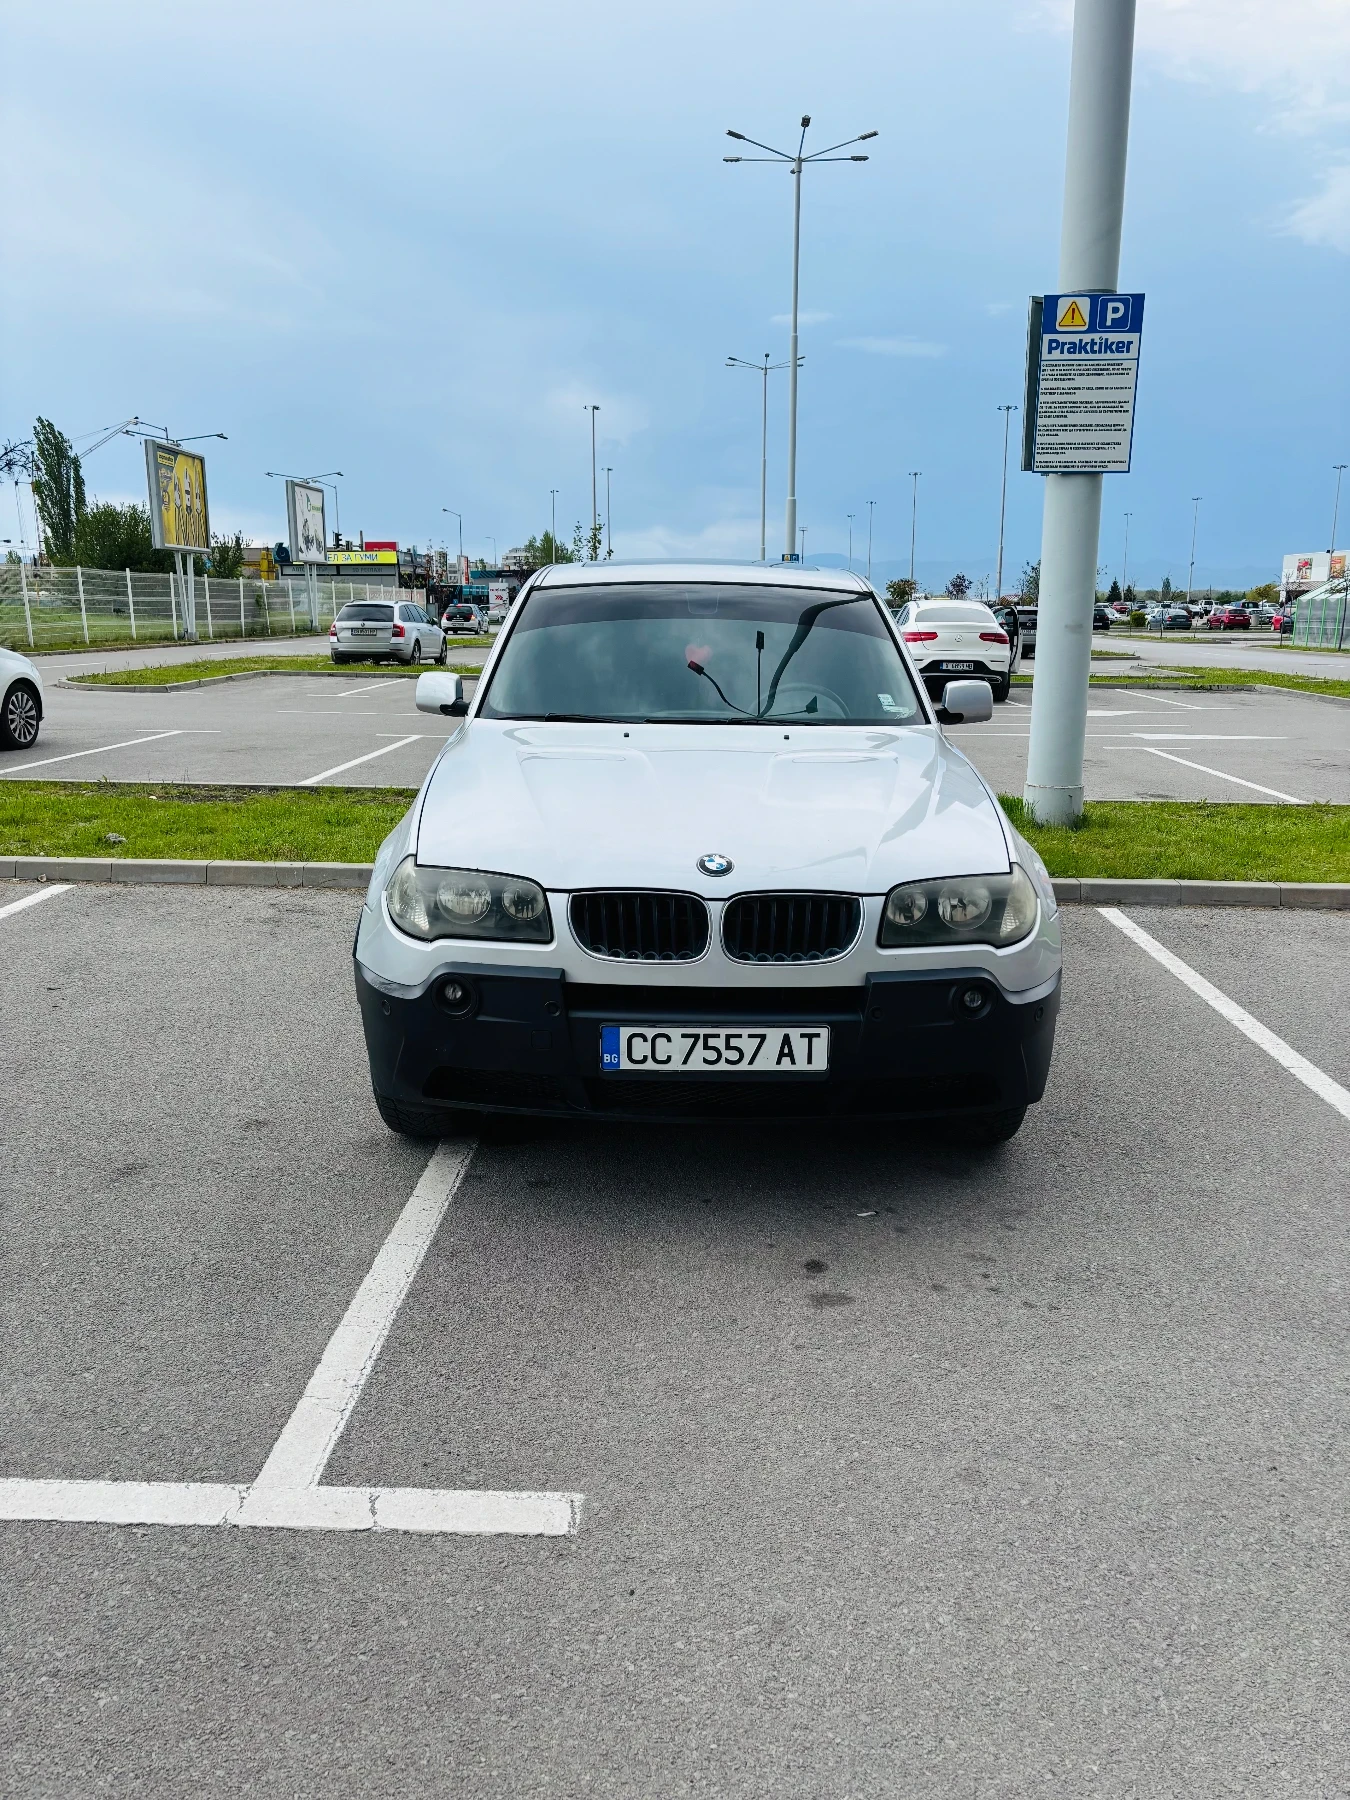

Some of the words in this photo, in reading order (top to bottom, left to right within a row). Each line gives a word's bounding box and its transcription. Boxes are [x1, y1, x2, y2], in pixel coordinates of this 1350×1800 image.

[1047, 336, 1134, 355] Praktiker
[341, 553, 352, 562] ЗА
[354, 553, 378, 562] ГУМИ
[626, 1032, 672, 1065] CC
[680, 1032, 767, 1066] 7557
[775, 1032, 821, 1066] AT
[603, 1053, 618, 1064] BG
